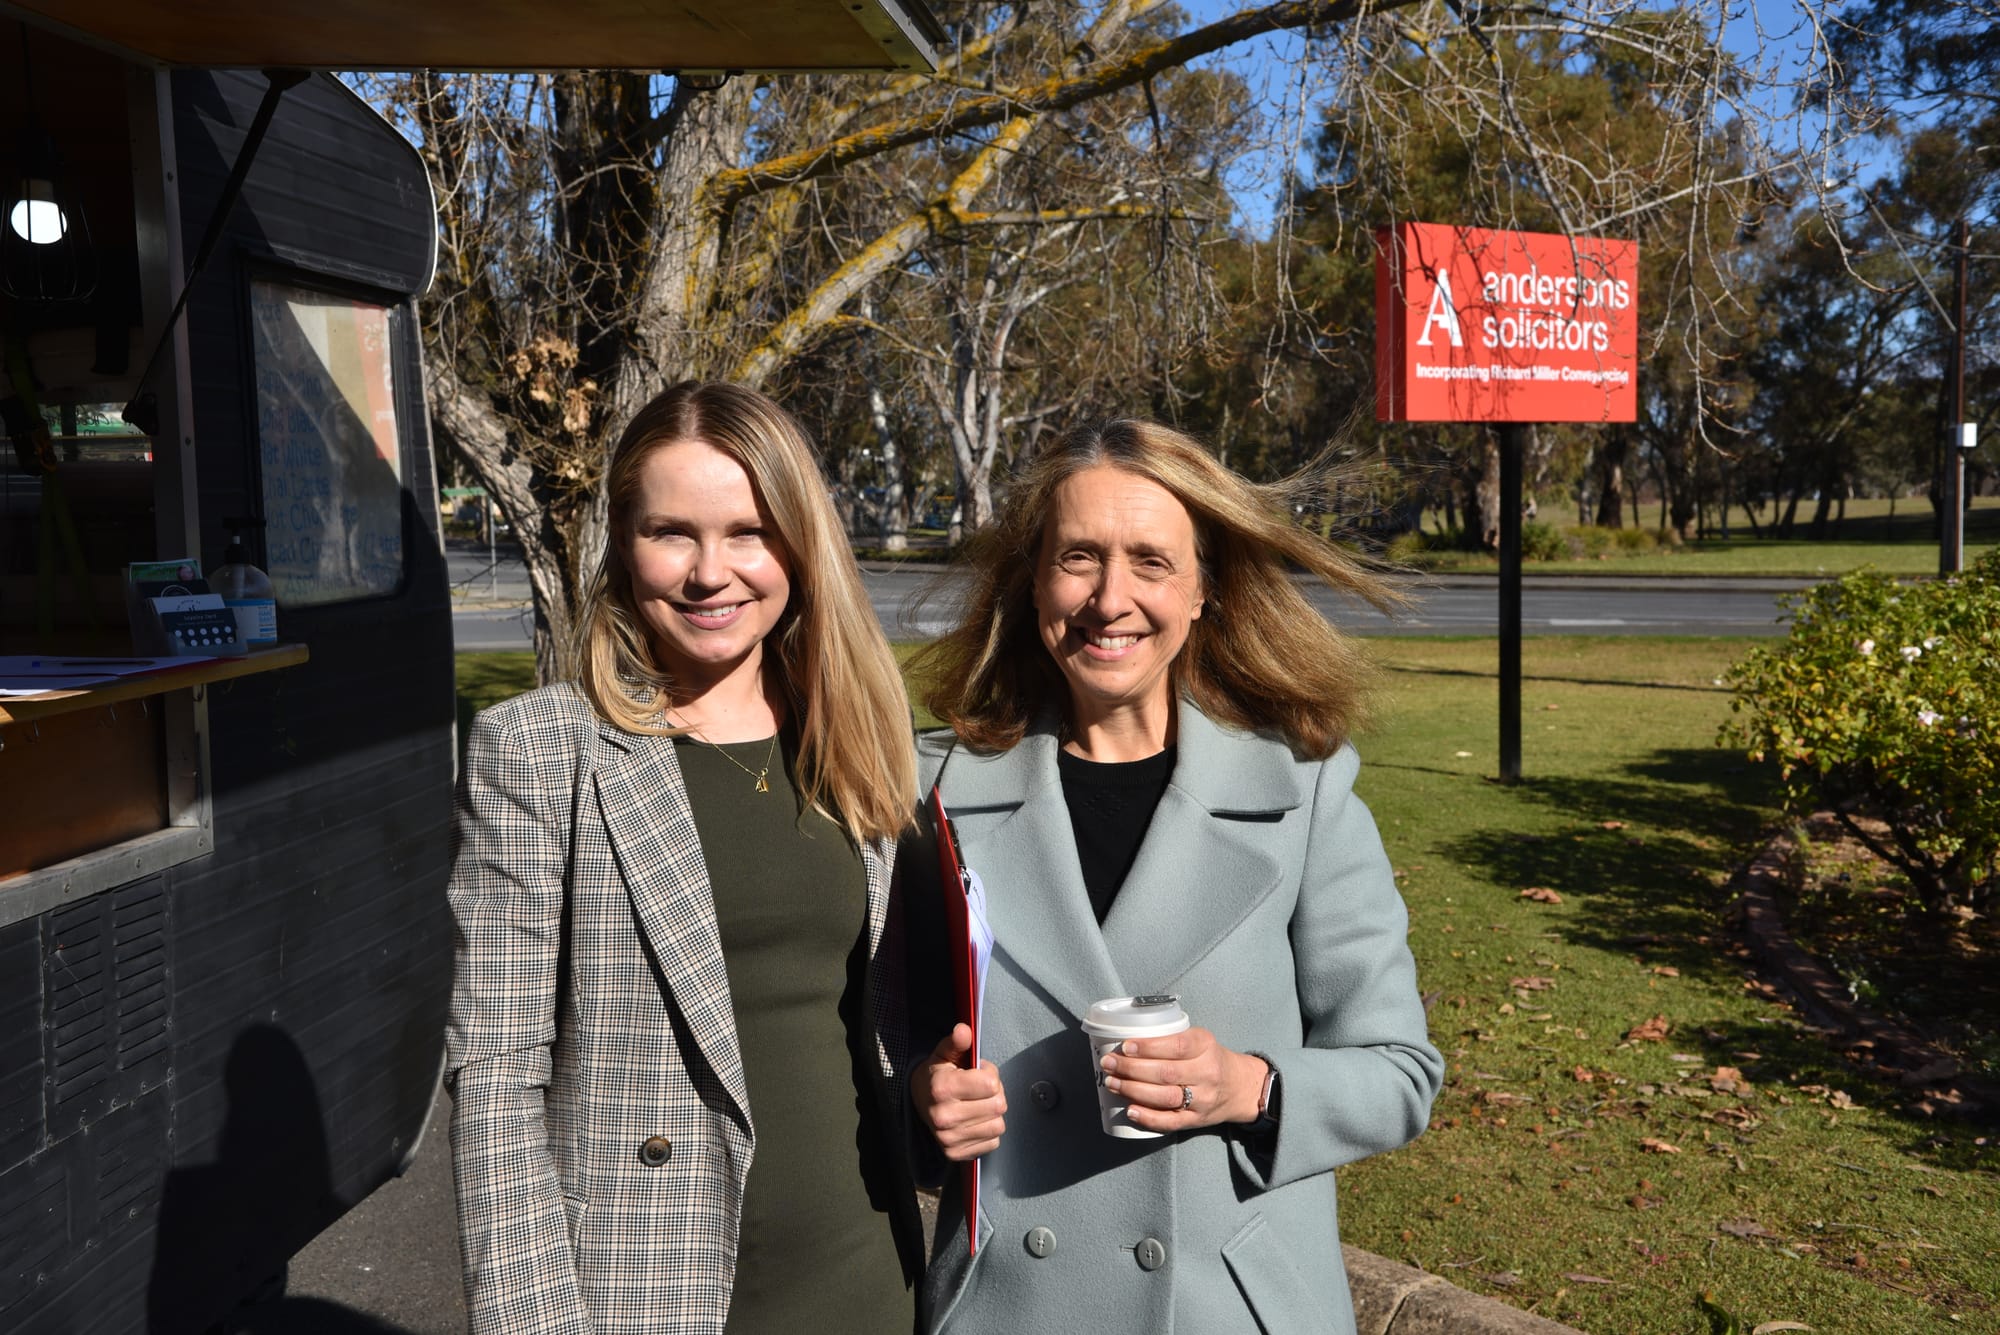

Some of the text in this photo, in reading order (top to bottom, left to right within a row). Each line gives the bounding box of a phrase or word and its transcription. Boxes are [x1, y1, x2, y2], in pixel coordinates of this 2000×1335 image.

[1415, 268, 1464, 347] A
[1482, 264, 1630, 309] andersons
[1482, 308, 1609, 352] solicitors
[1415, 362, 1629, 385] Incorporating Richard Miller Conveyancing
